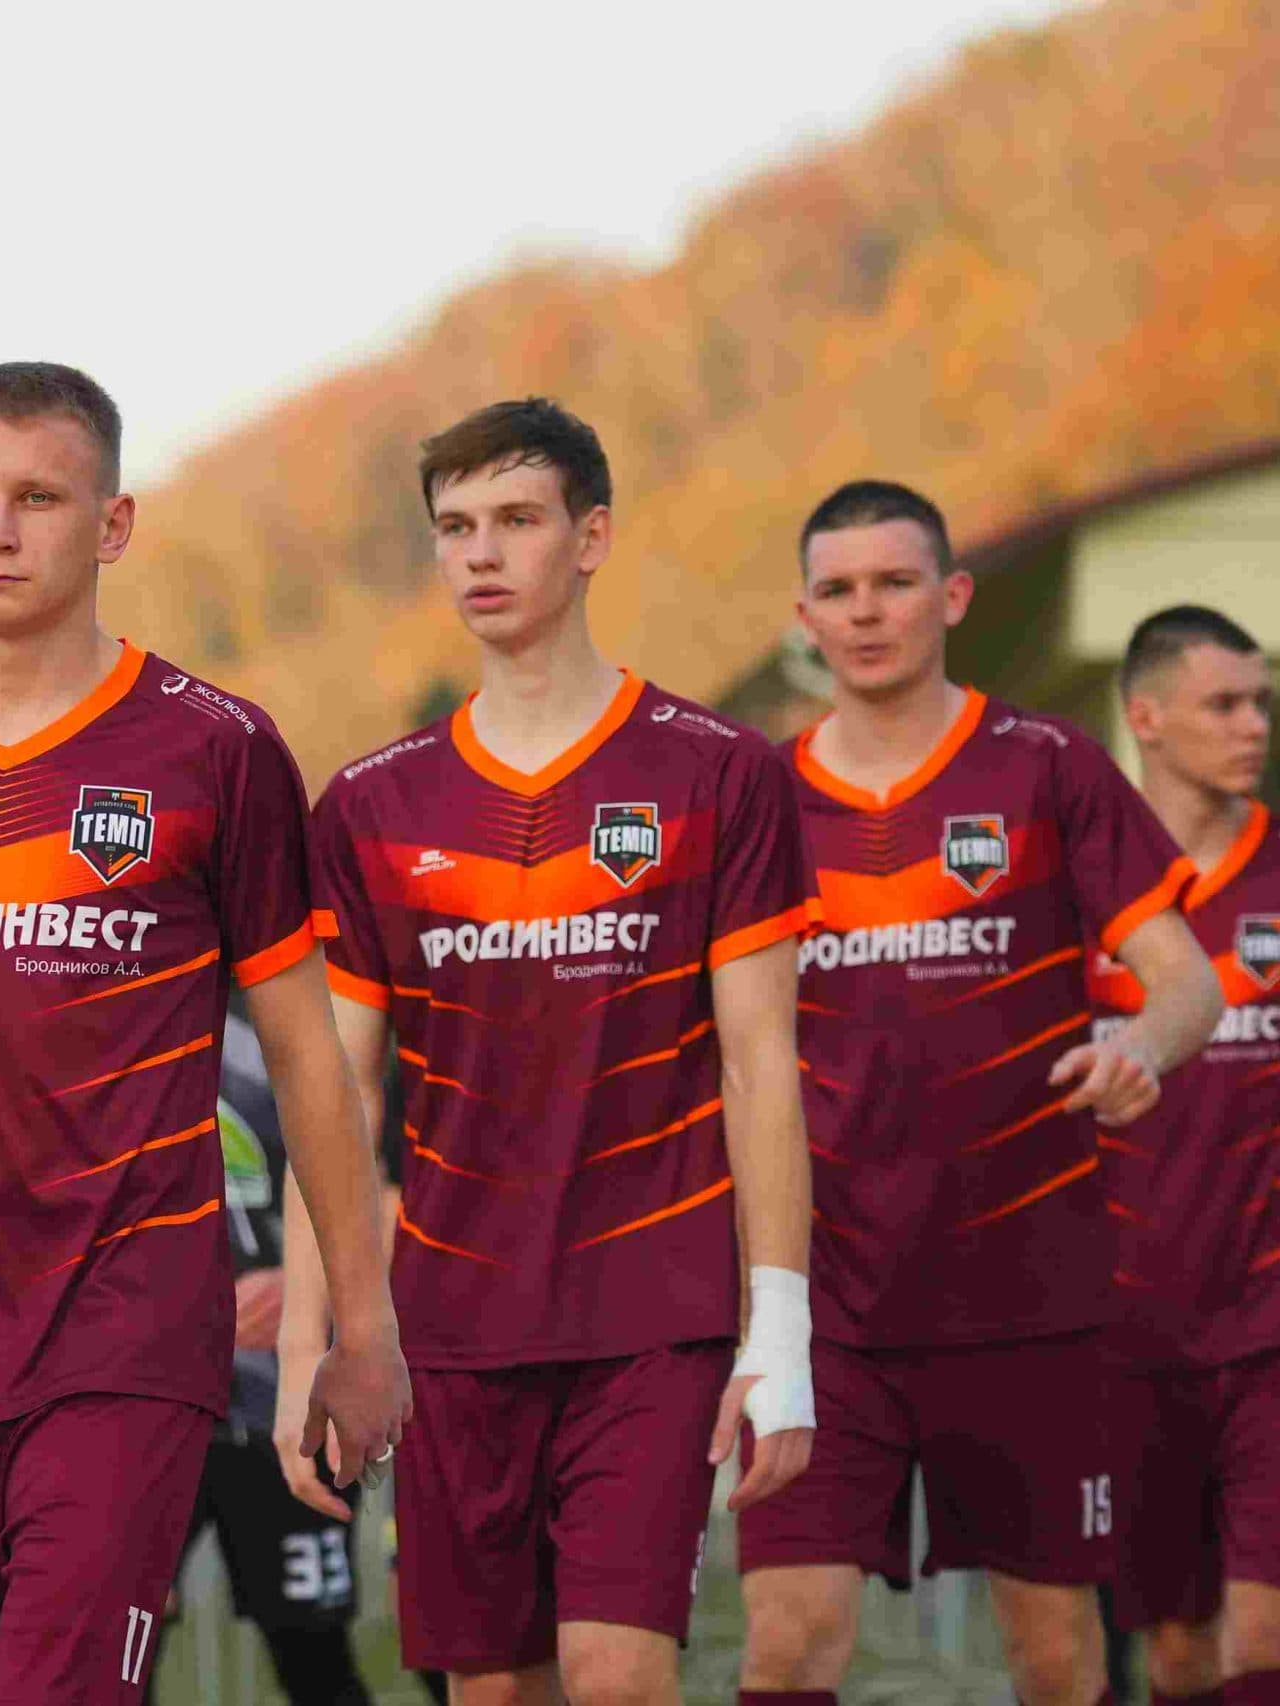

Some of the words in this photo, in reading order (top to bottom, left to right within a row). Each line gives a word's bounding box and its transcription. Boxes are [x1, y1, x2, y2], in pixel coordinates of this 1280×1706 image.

[190, 683, 256, 735] ЭКСКЛЮЗИВ
[81, 812, 146, 851] ТЕМП
[598, 826, 655, 857] ТЕМП
[797, 916, 1016, 975] РОДИНВЕСТ
[15, 957, 110, 975] Бродников
